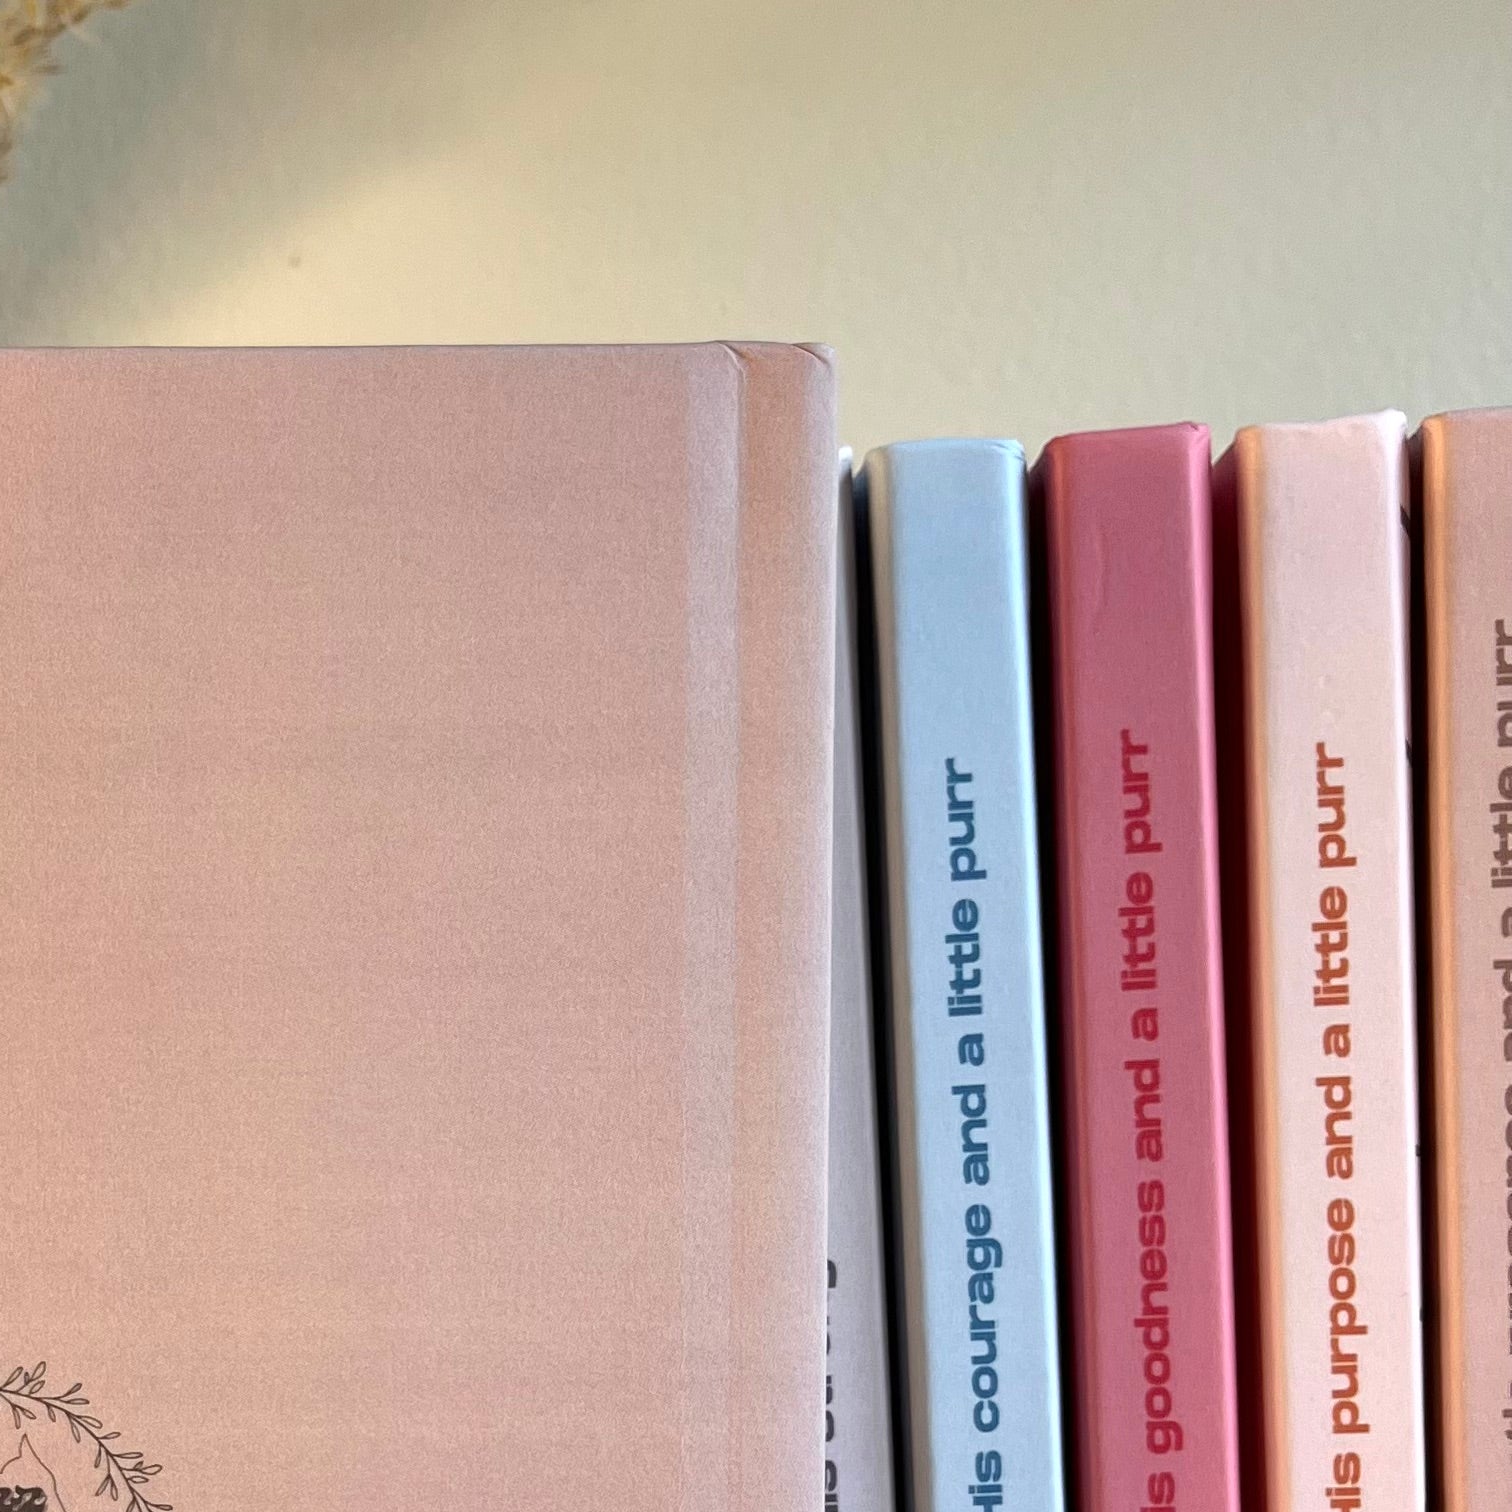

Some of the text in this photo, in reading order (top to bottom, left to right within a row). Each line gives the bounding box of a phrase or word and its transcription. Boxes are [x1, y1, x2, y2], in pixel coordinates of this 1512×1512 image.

[946, 758, 987, 881] purr
[1121, 729, 1162, 853] purr
[1316, 742, 1356, 868] purr
[945, 899, 982, 1016] little
[1119, 872, 1156, 991] little
[1312, 887, 1349, 1006] little
[958, 1033, 984, 1066] a
[1132, 1008, 1158, 1041] a
[1323, 1024, 1350, 1057] a
[952, 1084, 989, 1185] and
[1125, 1059, 1163, 1162] and
[1316, 1076, 1353, 1179] and
[965, 1205, 1003, 1432] courage
[1134, 1180, 1183, 1454] goodness
[1327, 1199, 1370, 1434] purpose
